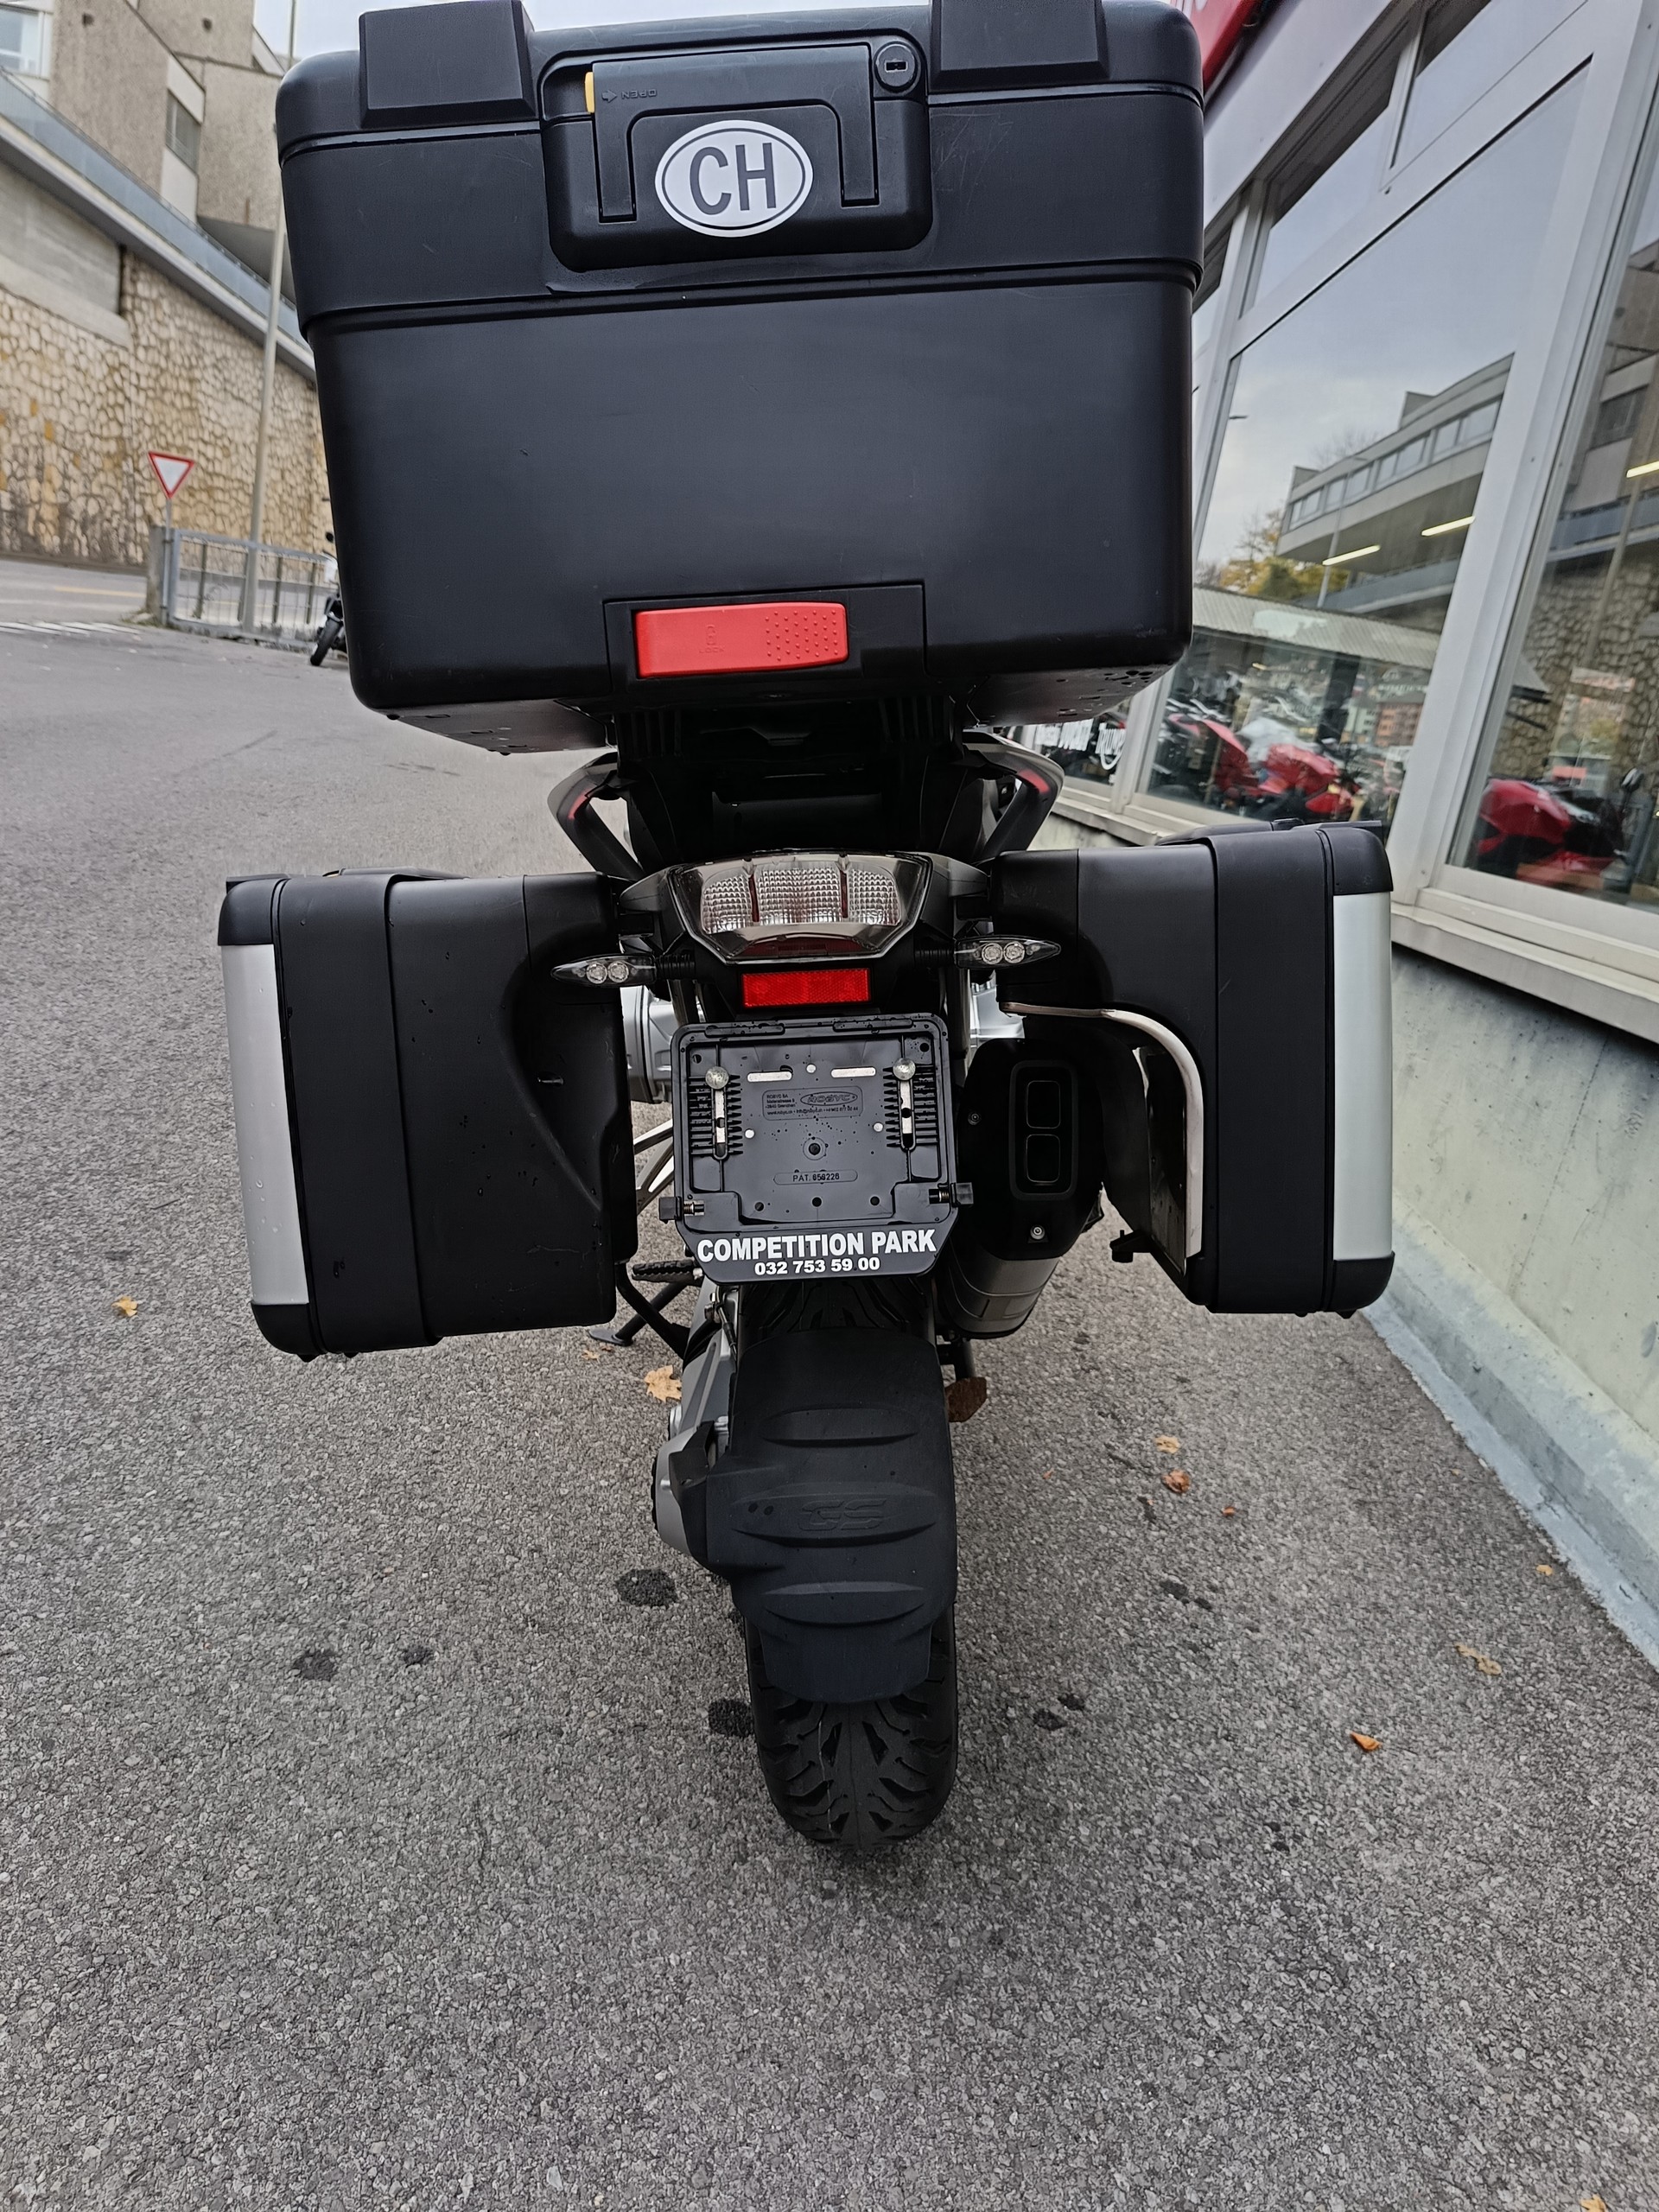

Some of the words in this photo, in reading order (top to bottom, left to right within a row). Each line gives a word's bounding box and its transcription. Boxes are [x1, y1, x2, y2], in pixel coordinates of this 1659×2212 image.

[621, 89, 658, 99] OPEN
[689, 142, 777, 215] CH
[697, 1233, 864, 1262] COMPETITION
[871, 1229, 937, 1255] PARK
[754, 1262, 788, 1275] 032
[792, 1259, 826, 1274] 753
[830, 1257, 854, 1272] 59
[857, 1256, 880, 1271] 00
[798, 1498, 887, 1531] GS
